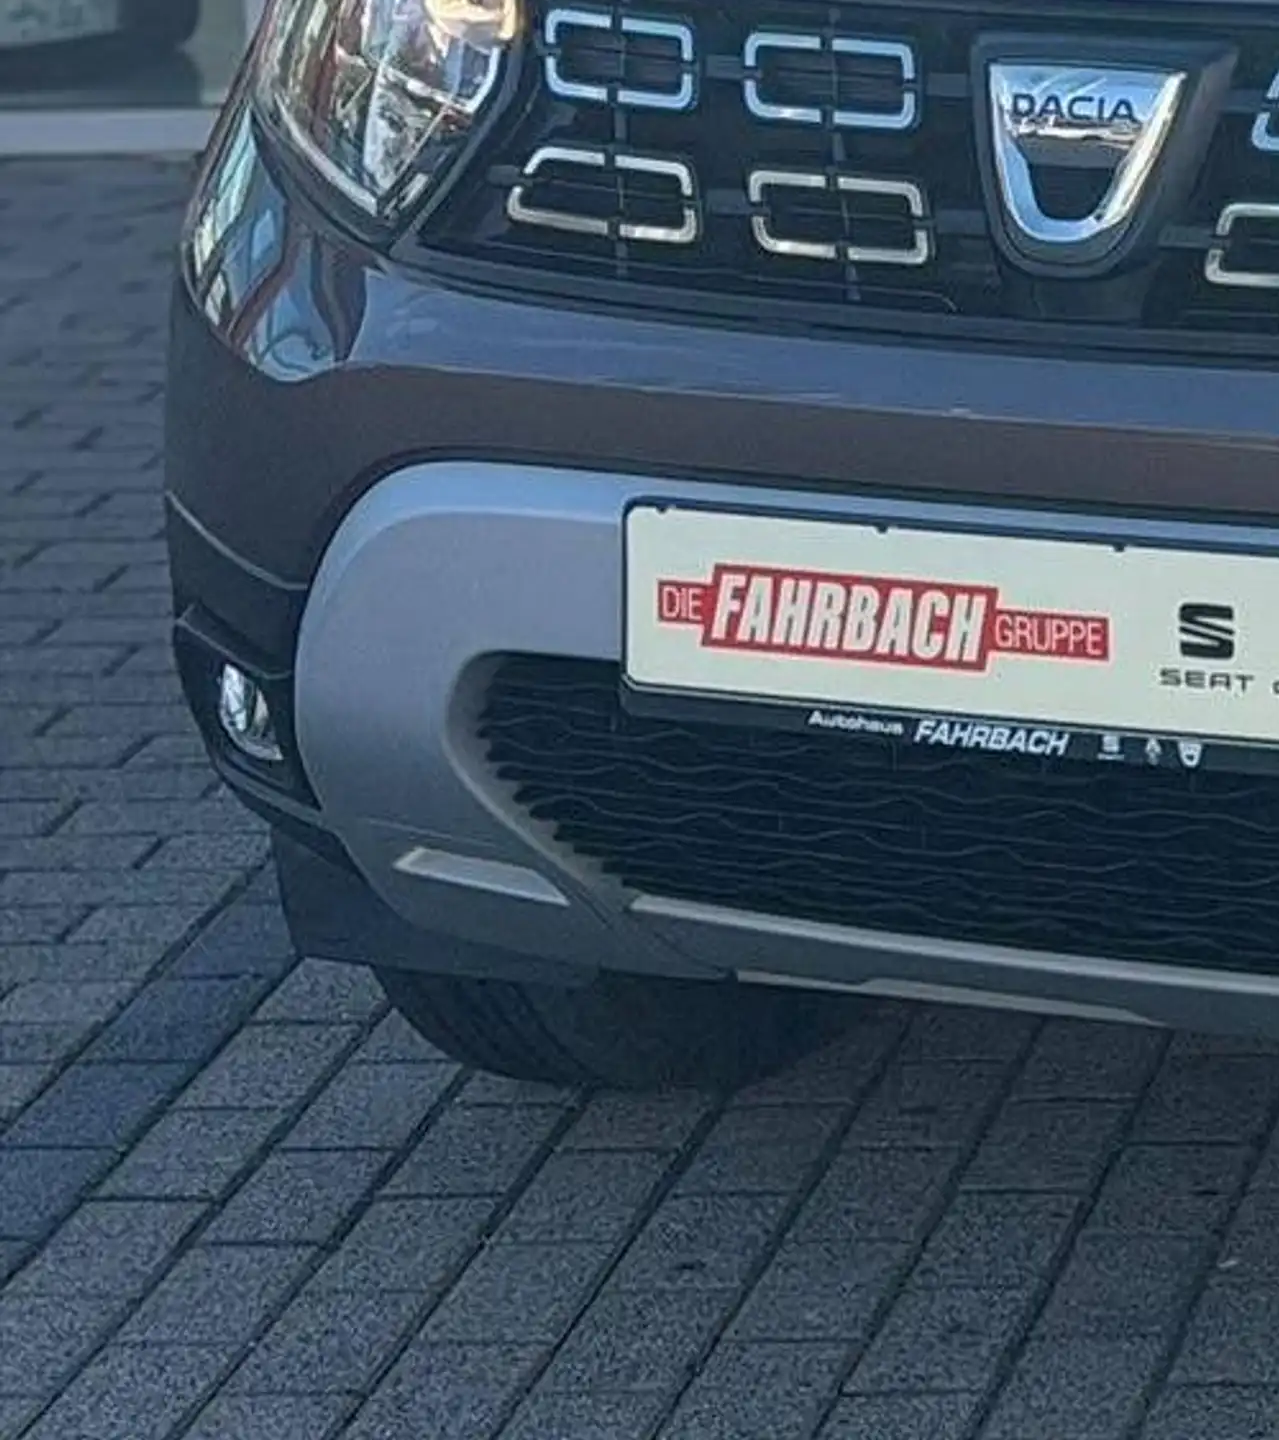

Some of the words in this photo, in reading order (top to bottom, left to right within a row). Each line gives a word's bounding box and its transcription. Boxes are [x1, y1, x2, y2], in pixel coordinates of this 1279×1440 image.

[1012, 93, 1138, 123] DACIA
[660, 584, 704, 621] DIE
[709, 572, 990, 663] FAHRBACH
[994, 614, 1105, 657] GRUPPE
[1159, 667, 1255, 693] SEAT
[808, 710, 905, 737] Autohaus
[913, 719, 1070, 757] FAHRBACH
